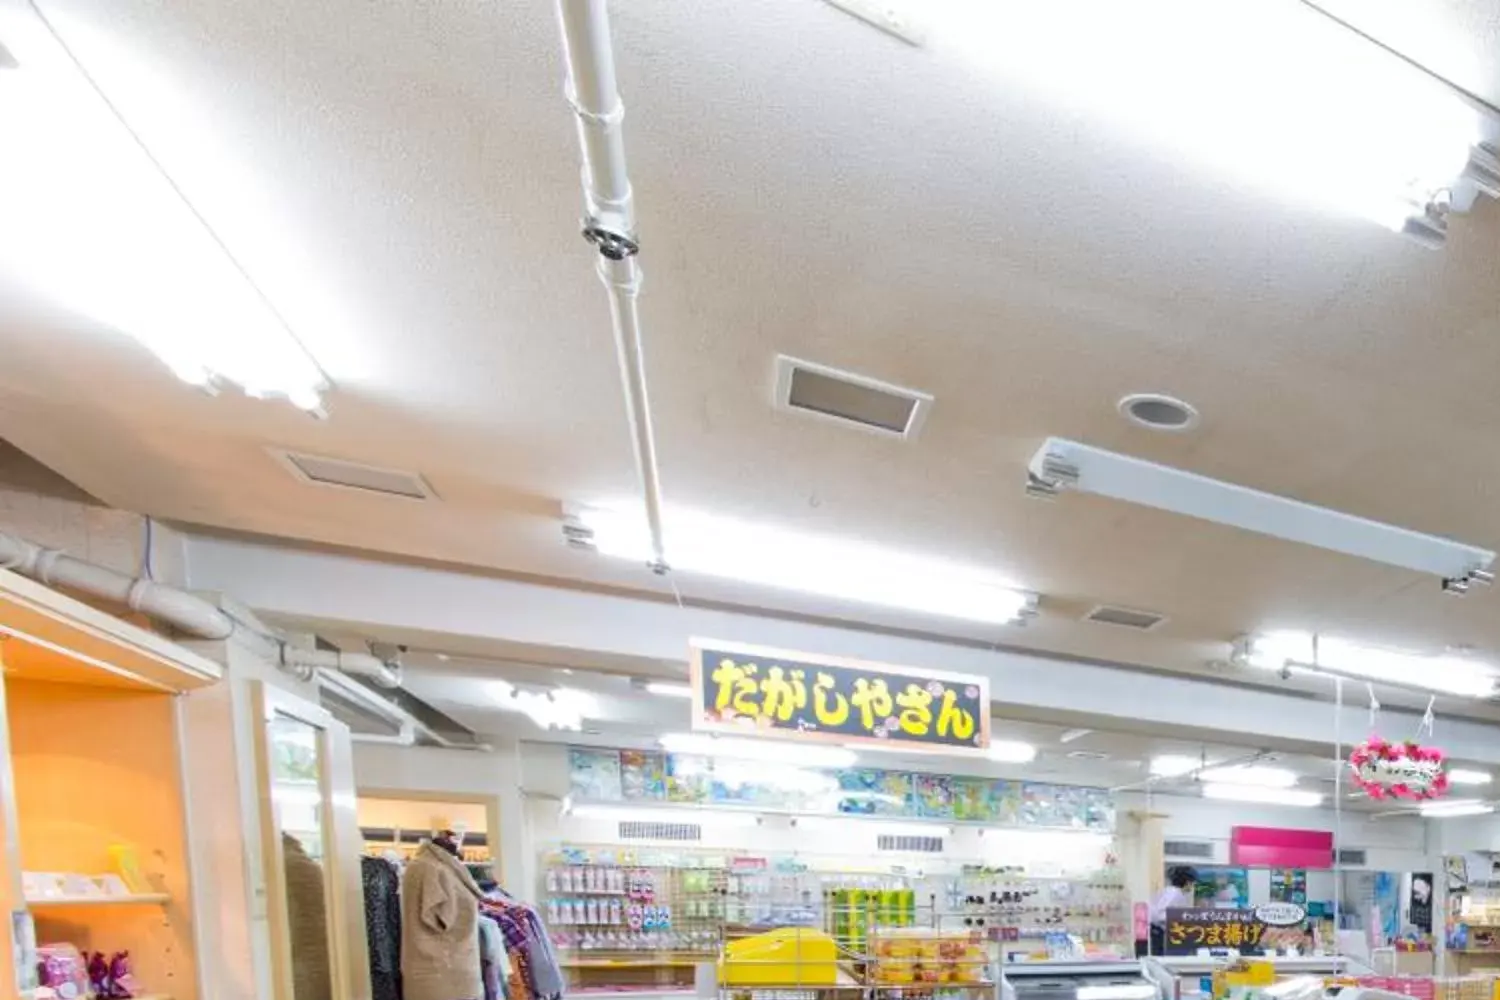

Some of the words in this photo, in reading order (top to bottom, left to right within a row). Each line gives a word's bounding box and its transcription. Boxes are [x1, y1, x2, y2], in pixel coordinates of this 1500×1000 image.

[712, 659, 974, 740] だがしやさん
[1169, 921, 1263, 945] さつま揚げ
